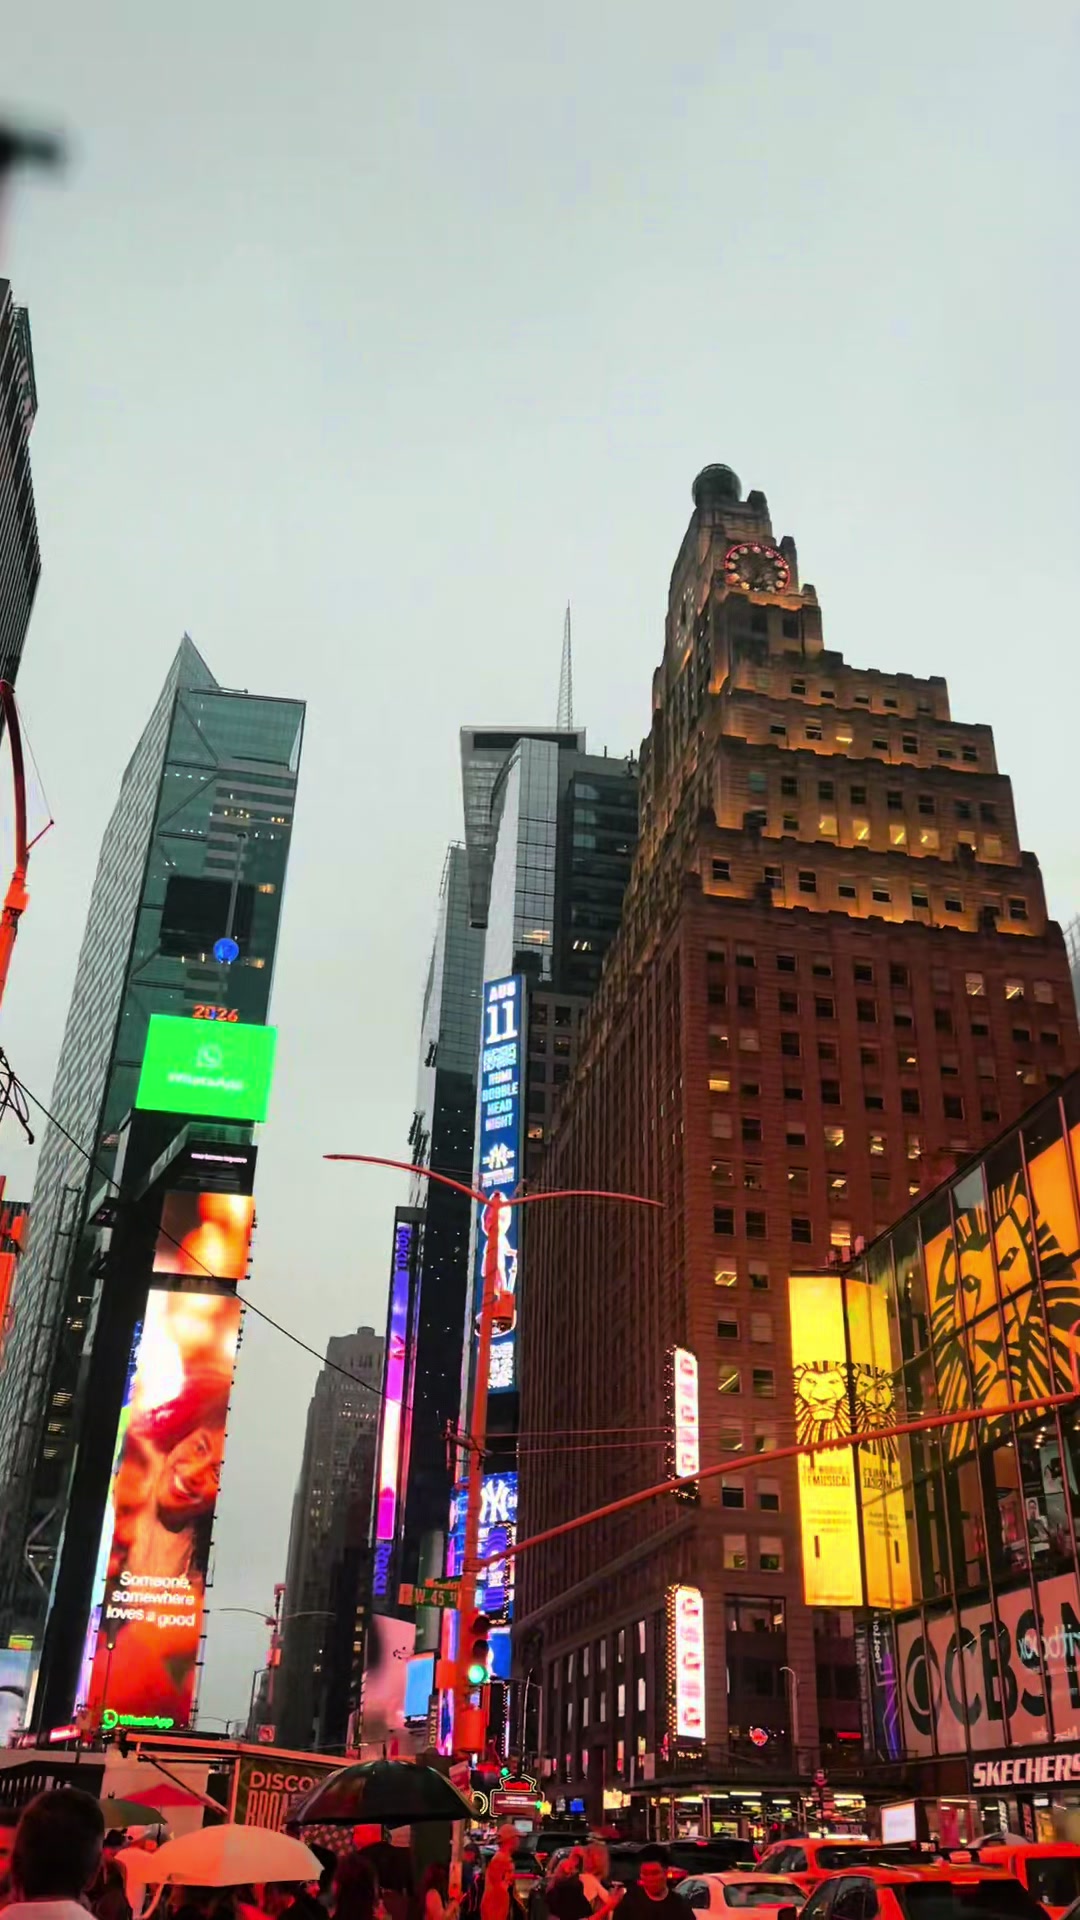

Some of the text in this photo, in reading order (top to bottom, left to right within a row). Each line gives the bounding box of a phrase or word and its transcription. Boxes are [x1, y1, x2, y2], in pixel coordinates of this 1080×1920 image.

[489, 980, 516, 1002] AUG
[192, 1004, 239, 1022] 2026
[486, 1000, 518, 1044] 11
[120, 1571, 191, 1591] Someone,
[112, 1590, 195, 1606] somewhere
[415, 1588, 426, 1604] W
[431, 1589, 445, 1606] 45
[106, 1604, 196, 1629] loves a good
[945, 1609, 1053, 1726] CBS
[428, 1704, 438, 1748] QUARE
[973, 1753, 1080, 1787] SKECHERS
